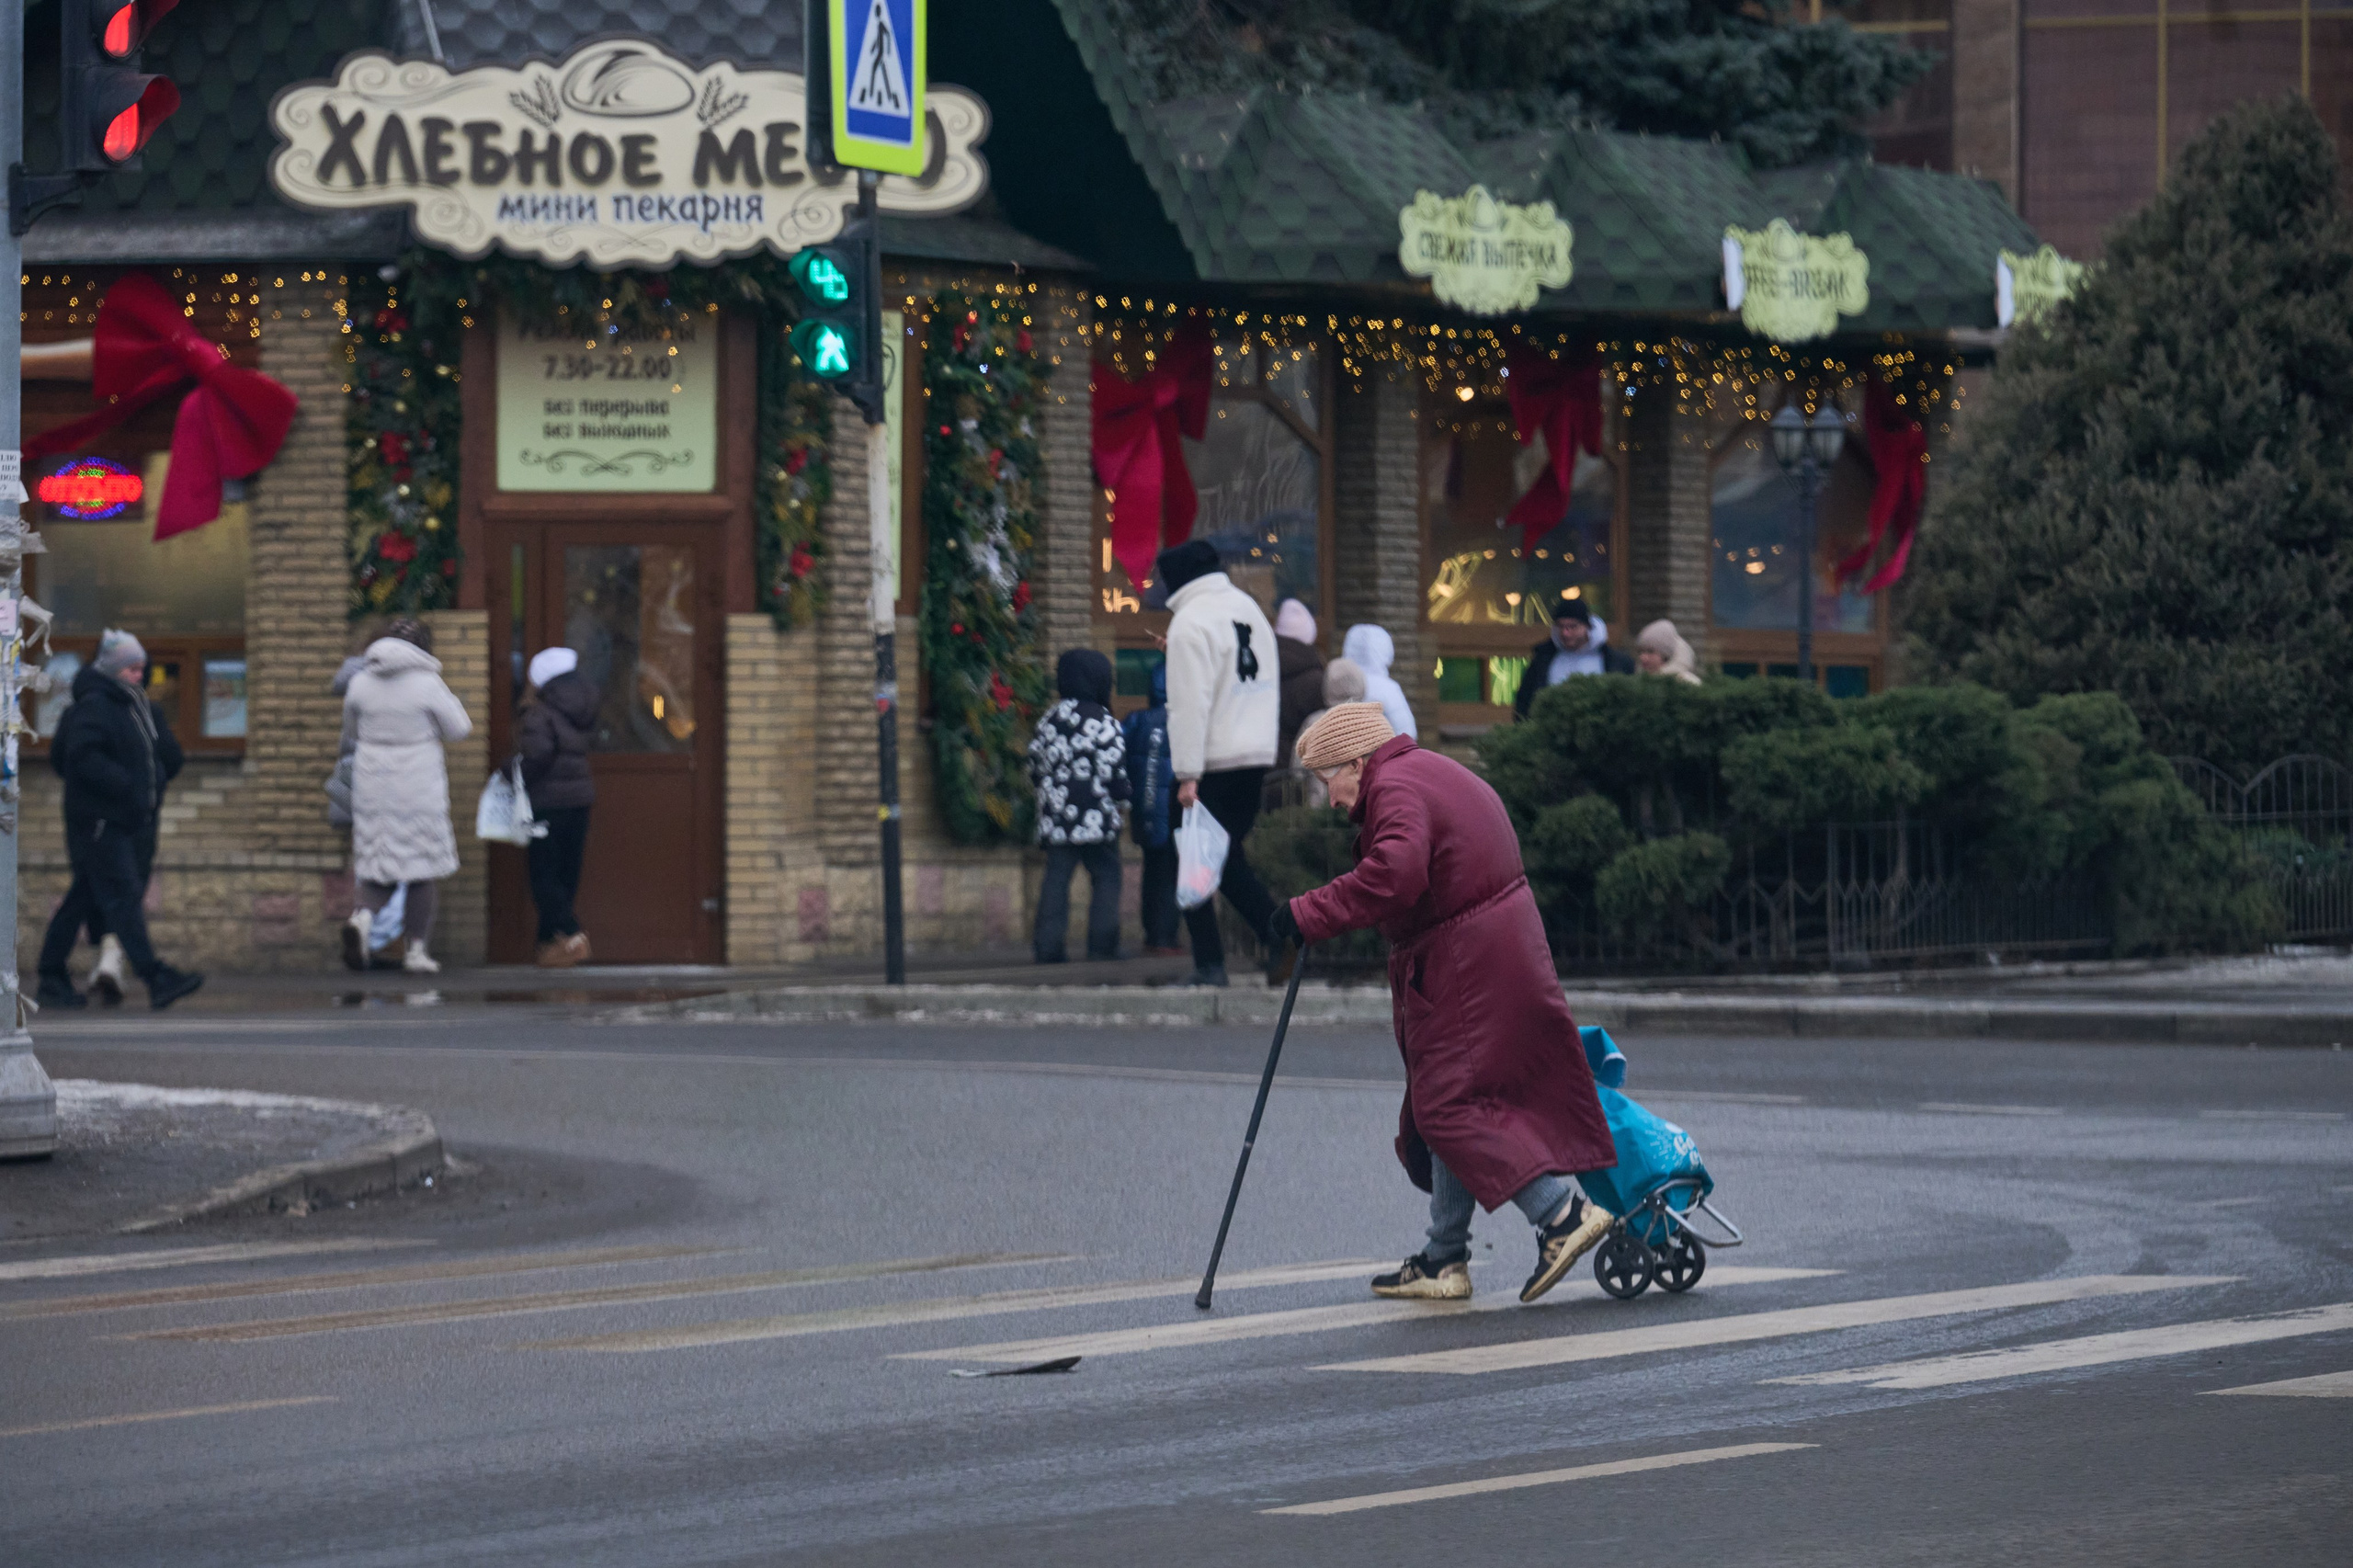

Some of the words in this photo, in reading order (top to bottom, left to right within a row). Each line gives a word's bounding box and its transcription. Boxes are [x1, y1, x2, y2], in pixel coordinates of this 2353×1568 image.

[318, 104, 664, 186] ХЛЕБНОЕ
[695, 108, 947, 189] МЕО
[498, 195, 598, 224] мини
[614, 196, 765, 233] пекарня
